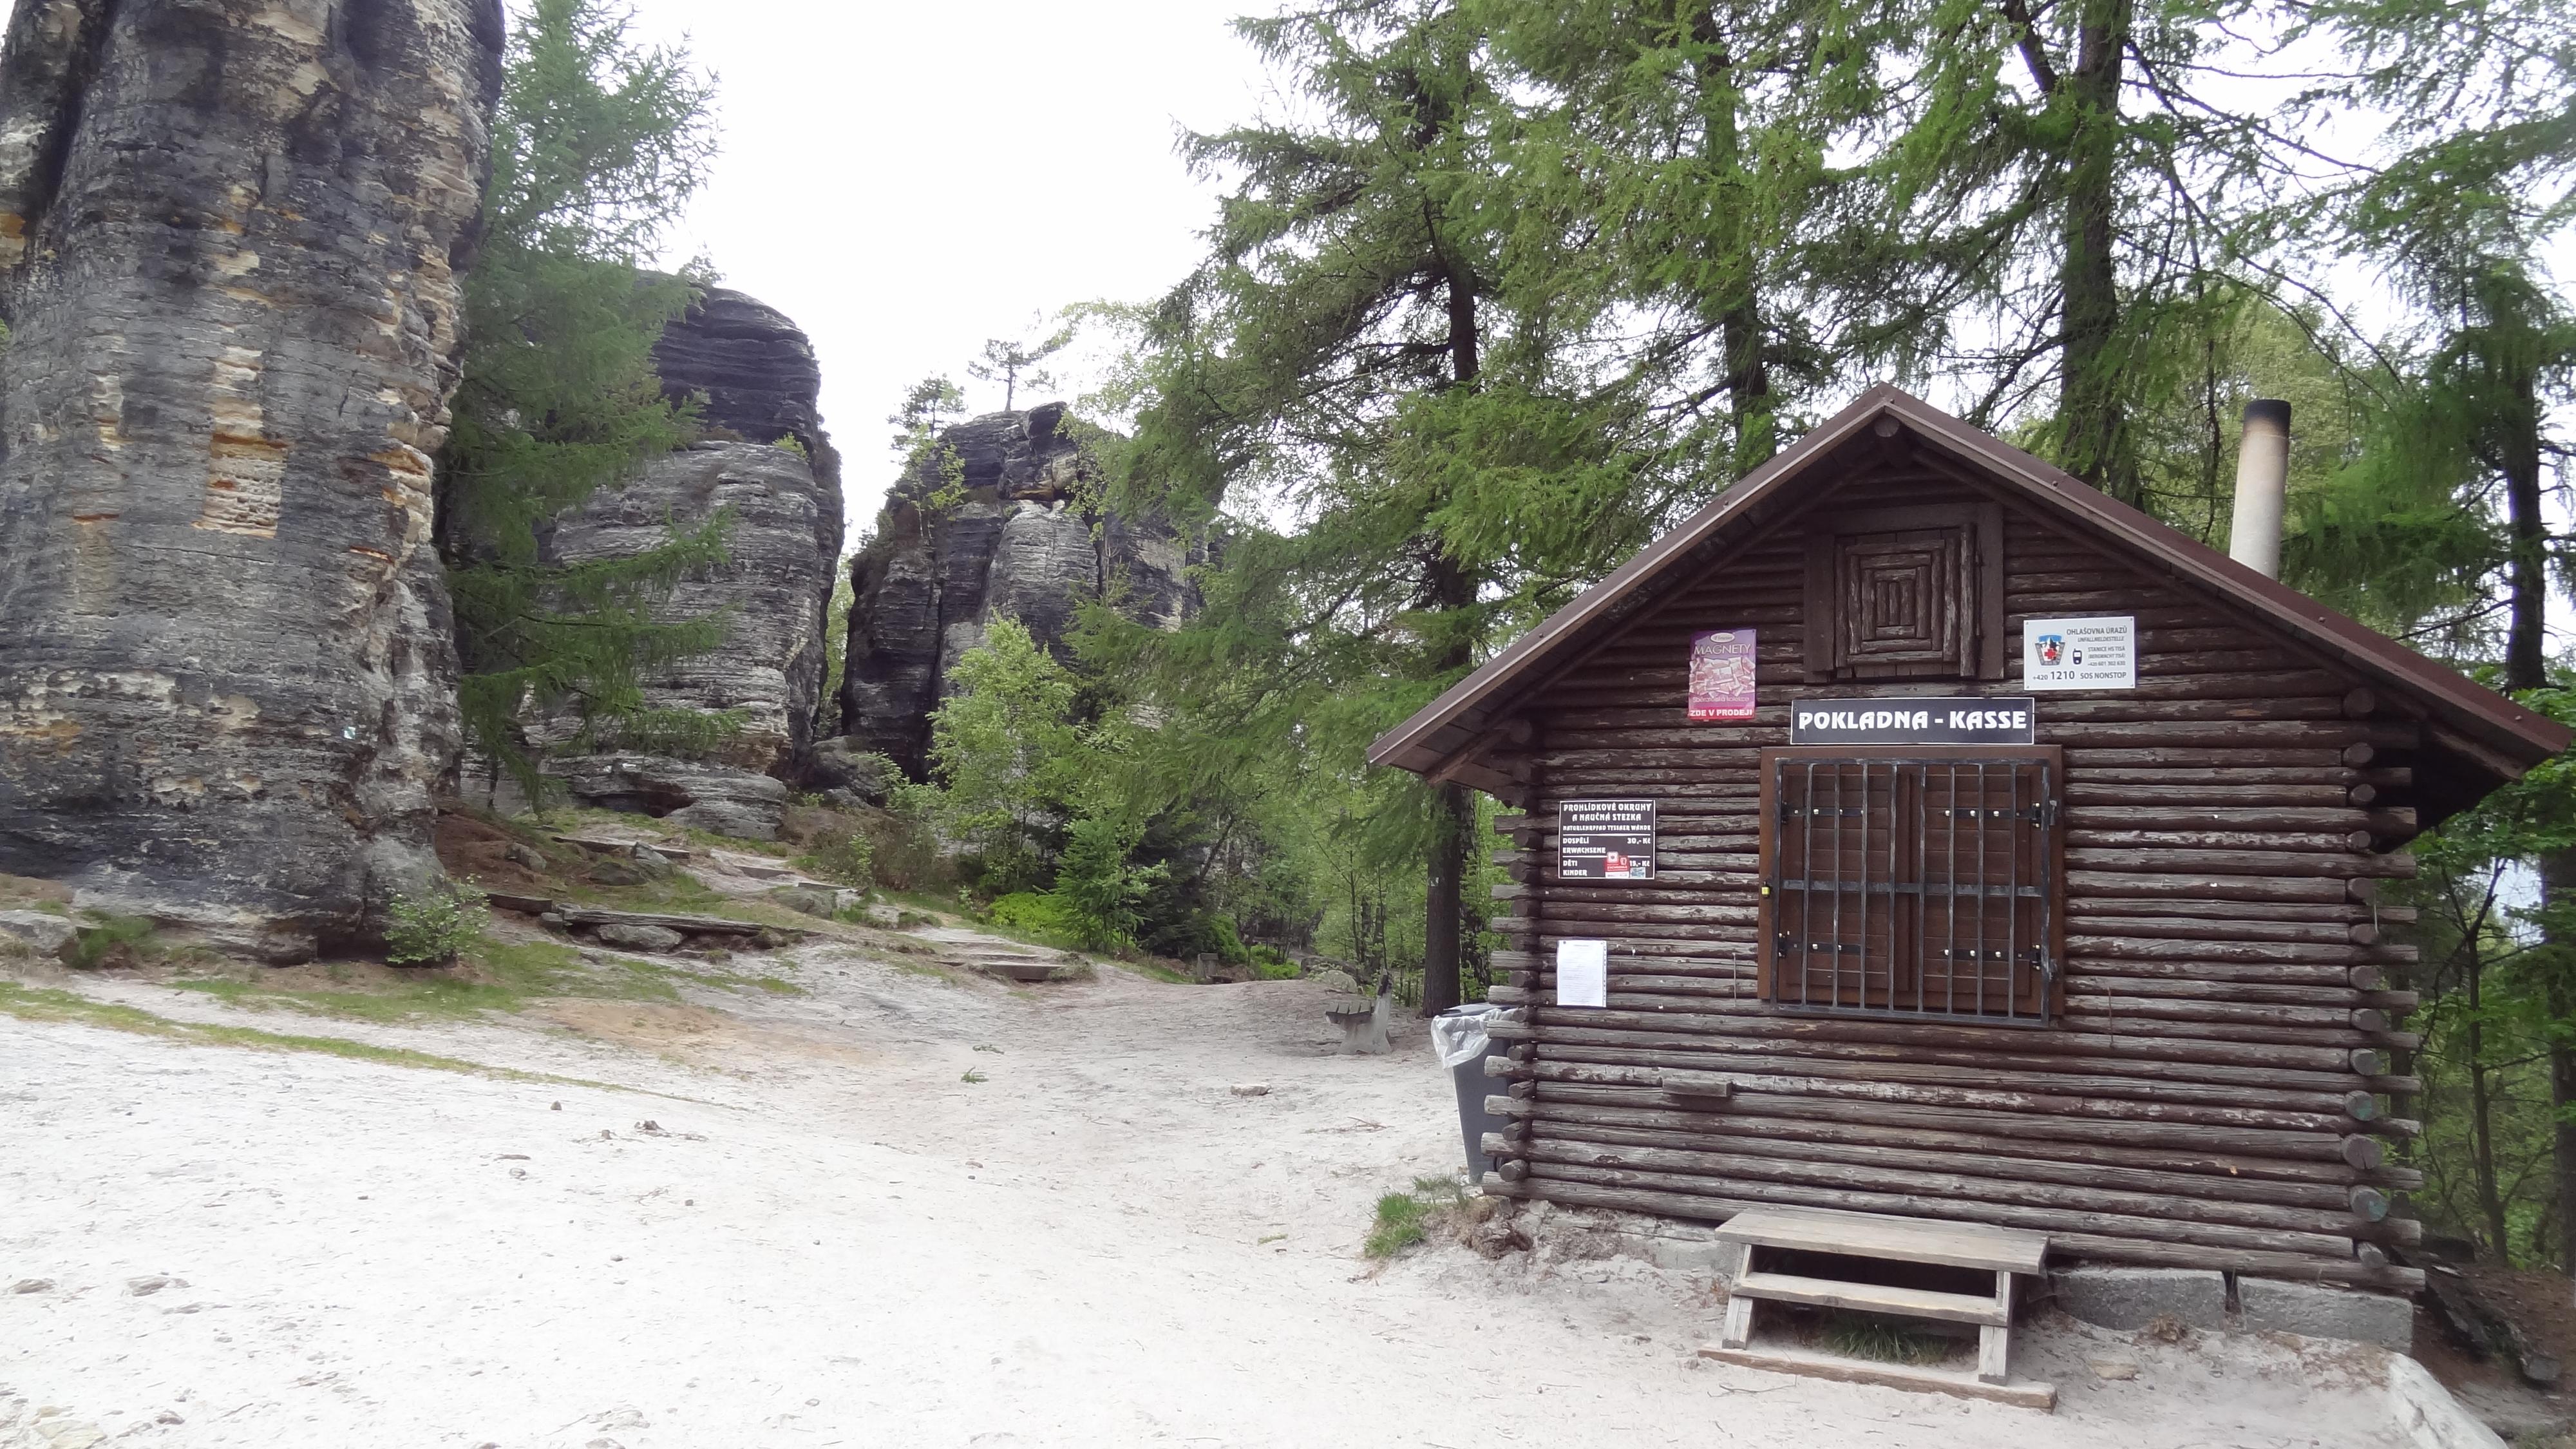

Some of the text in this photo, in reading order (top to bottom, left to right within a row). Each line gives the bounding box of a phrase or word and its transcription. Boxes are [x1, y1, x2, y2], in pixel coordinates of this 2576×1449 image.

[2067, 625, 2127, 635] OHLAŠOVNA ÚRAZŮ
[1694, 643, 1751, 655] MAGNETY
[2050, 670, 2075, 680] 1210
[1799, 711, 1928, 730] POKLADNA
[1949, 710, 2027, 730] KASSE
[1564, 802, 1652, 811] PROHLÍDKOVÉ OKRUHY
[1580, 812, 1610, 821] NAUČNÁ
